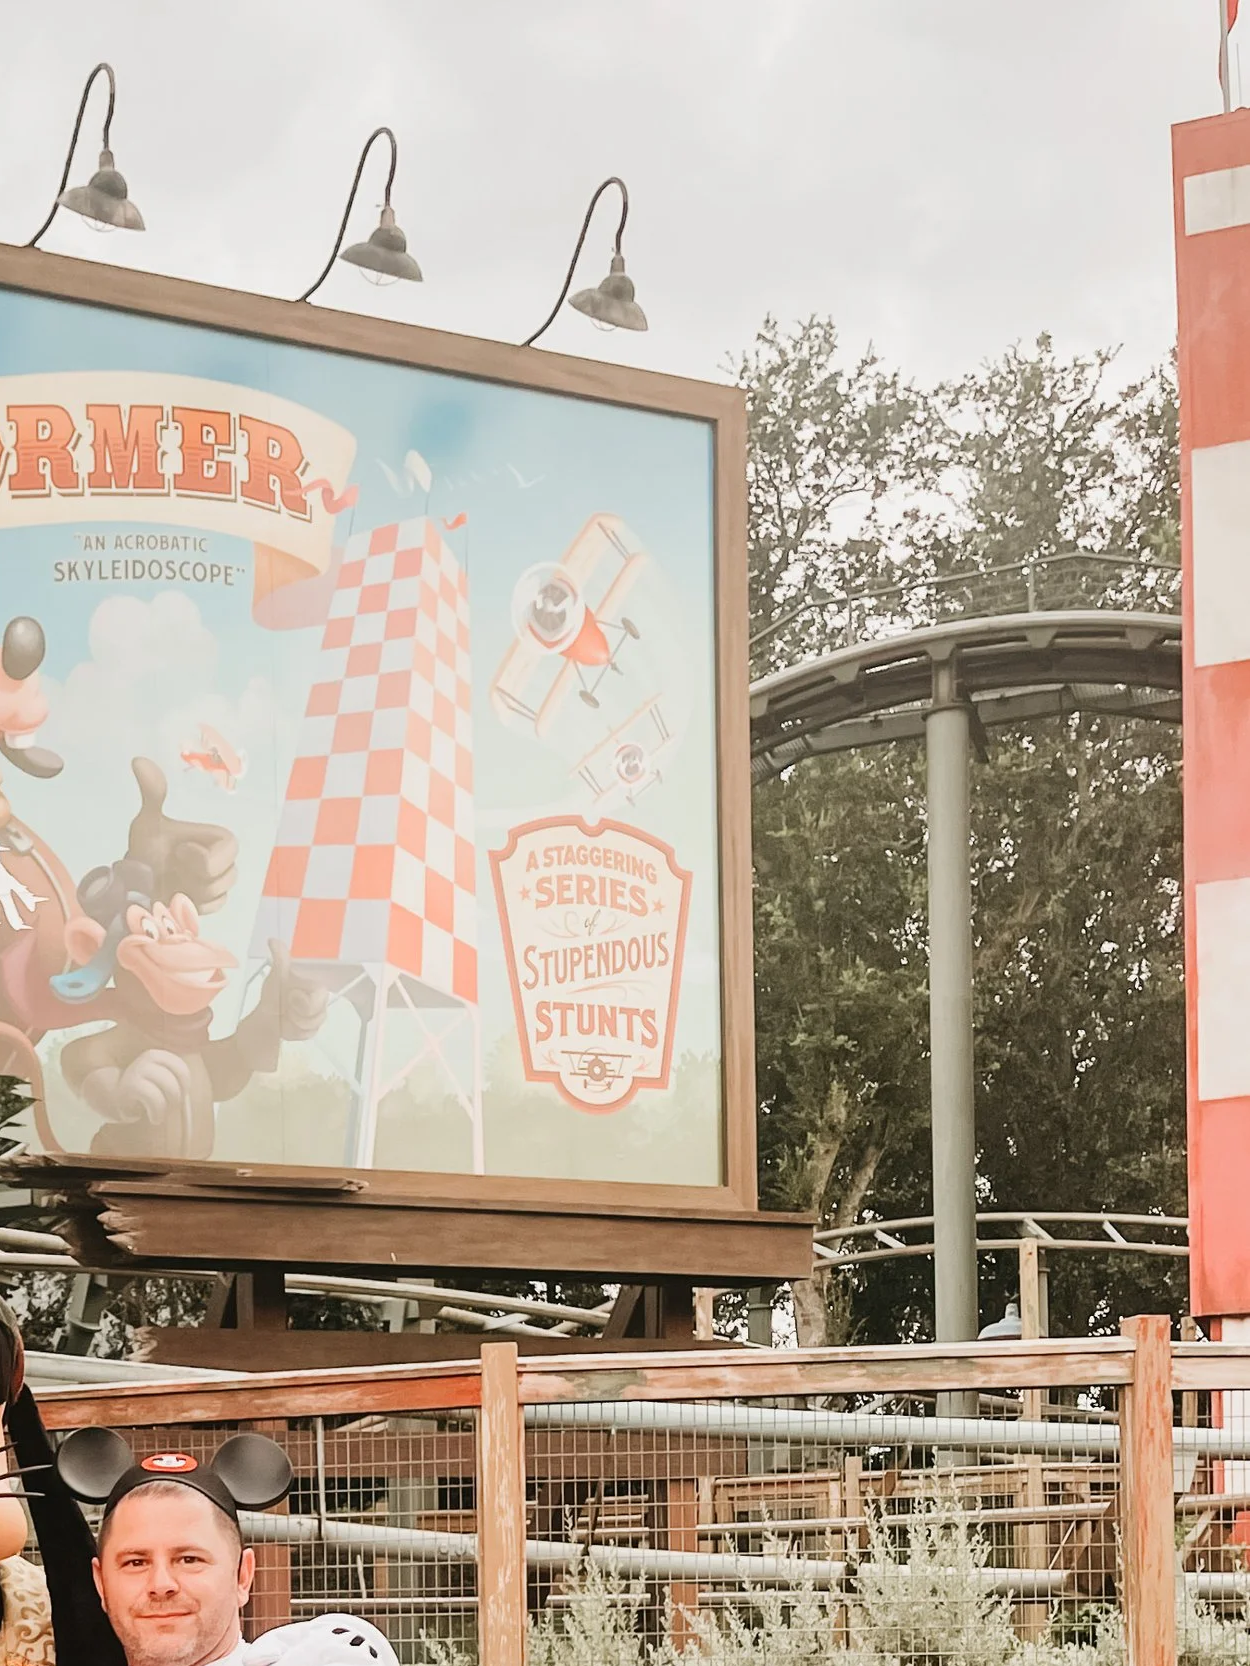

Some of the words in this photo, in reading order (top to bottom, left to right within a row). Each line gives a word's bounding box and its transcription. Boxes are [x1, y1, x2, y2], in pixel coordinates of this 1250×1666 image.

[113, 535, 208, 553] ACROBATIC
[525, 850, 539, 872] A
[543, 844, 658, 885] STAGGERING
[535, 874, 648, 917] SERIES
[584, 909, 601, 936] of
[522, 932, 670, 990] STUPENDOUS
[535, 1000, 659, 1049] STUNTS
